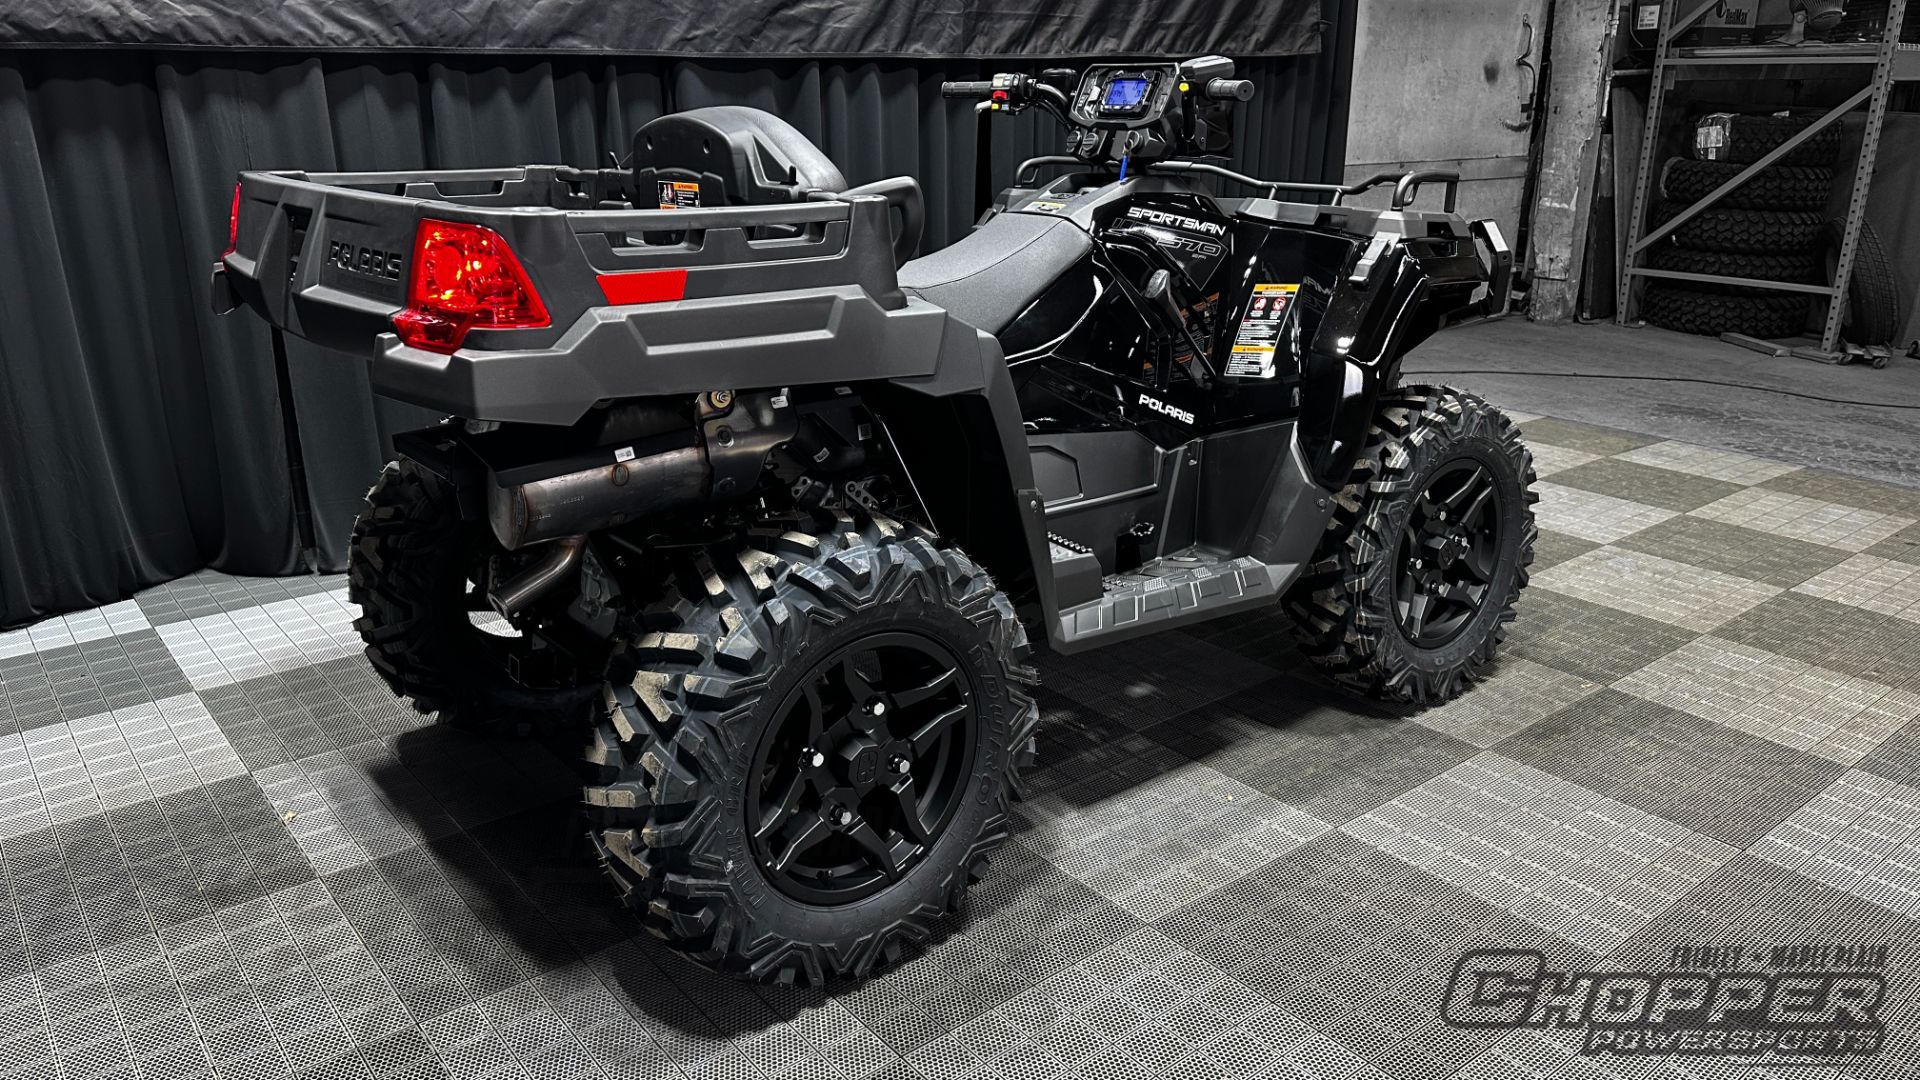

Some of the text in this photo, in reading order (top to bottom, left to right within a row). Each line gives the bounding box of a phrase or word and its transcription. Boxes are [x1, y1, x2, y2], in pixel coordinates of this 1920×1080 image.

[1127, 206, 1226, 236] SPORTSMAN
[328, 240, 402, 281] POLARIS
[1156, 236, 1221, 256] 570
[1138, 393, 1195, 425] POLARIS
